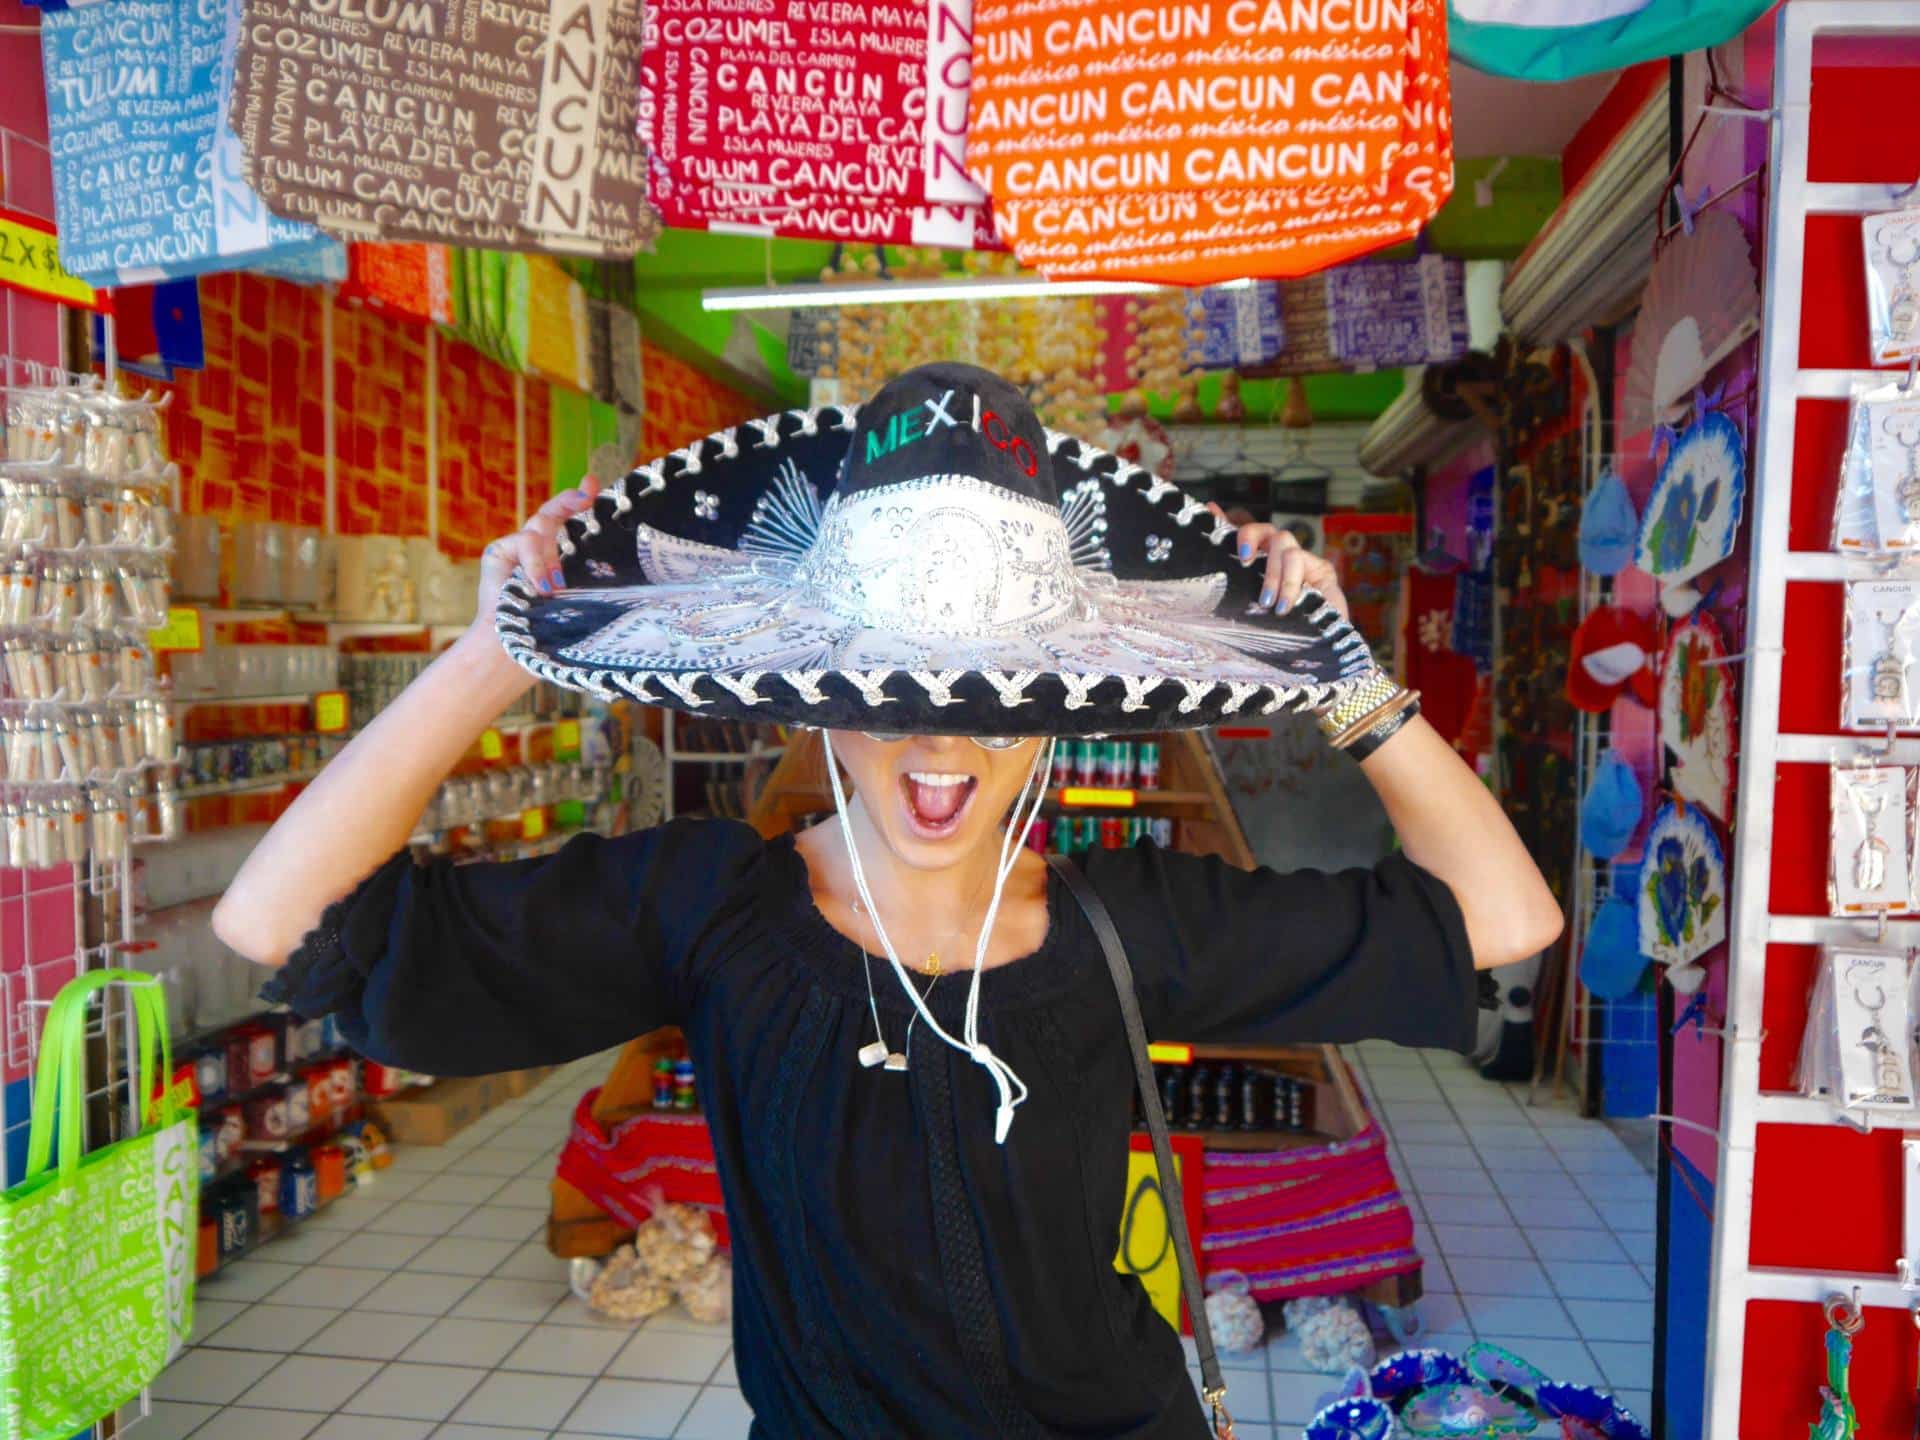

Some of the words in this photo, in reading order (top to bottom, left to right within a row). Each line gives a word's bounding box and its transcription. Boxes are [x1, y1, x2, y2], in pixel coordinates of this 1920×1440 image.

[252, 0, 297, 22] ISLA
[300, 11, 370, 37] MUJERES
[290, 0, 434, 34] LUM
[663, 17, 797, 47] COZUMEL
[787, 1, 867, 25] RIVIERA
[872, 5, 928, 29] MAYA
[1044, 4, 1211, 55] CANCUN
[1226, 0, 1408, 37] CANCUN
[72, 18, 173, 54] CANCUN
[114, 47, 166, 65] MAYA
[251, 23, 392, 73] COZUMEL
[383, 31, 467, 65] RIVIERA
[472, 51, 530, 81] MAYA
[809, 28, 856, 49] ISLA
[249, 53, 267, 91] ISLA
[664, 50, 679, 91] ISLA
[719, 47, 767, 64] PLAYA
[768, 49, 794, 65] DEL
[797, 51, 857, 70] CARMEN
[992, 60, 1079, 89] méxico
[1084, 46, 1177, 76] méxico
[1181, 38, 1285, 65] méxico
[1289, 35, 1393, 62] méxico
[57, 66, 158, 110] TULUM
[270, 57, 298, 146] CANCUN
[311, 63, 358, 84] PLAYA
[361, 72, 389, 90] DEL
[391, 79, 455, 103] CARMEN
[406, 59, 454, 84] ISLA
[459, 73, 539, 104] MUJERES
[688, 47, 709, 144] CANCUN
[717, 63, 883, 102] CANCUN
[1120, 73, 1296, 119] CANCUN
[117, 97, 180, 117] RIVIERA
[305, 78, 475, 132] CANCUN
[718, 105, 812, 138] PLAYA
[818, 113, 871, 144] DEL
[876, 117, 927, 144] CA
[751, 93, 825, 114] RIVIERA
[829, 97, 881, 118] MAYA
[51, 121, 125, 158] COZUMEL
[131, 114, 170, 135] ISLA
[304, 114, 402, 159] PLAYA
[408, 137, 465, 169] DEL
[340, 109, 416, 137] RIVIERA
[422, 124, 476, 149] MAYA
[723, 135, 764, 153] ISLA
[767, 138, 835, 160] MUJERES
[995, 127, 1085, 154] méxico
[1091, 117, 1182, 144] méxico
[1189, 113, 1290, 139] méxico
[1295, 108, 1399, 134] méxico
[80, 152, 185, 191] CANCUN
[306, 142, 350, 165] ISLA
[353, 154, 424, 181] MUJERES
[681, 155, 758, 183] TULUM
[769, 159, 910, 196] CANCUN
[1006, 149, 1171, 195] CANCUN
[1184, 141, 1367, 184] CANCUN
[261, 154, 344, 190] TULUM
[353, 172, 499, 223] CANCUN
[83, 200, 139, 229] PLAYA
[141, 189, 175, 218] DEL
[114, 229, 208, 269] CANCUN
[865, 389, 1038, 478] MEXICO
